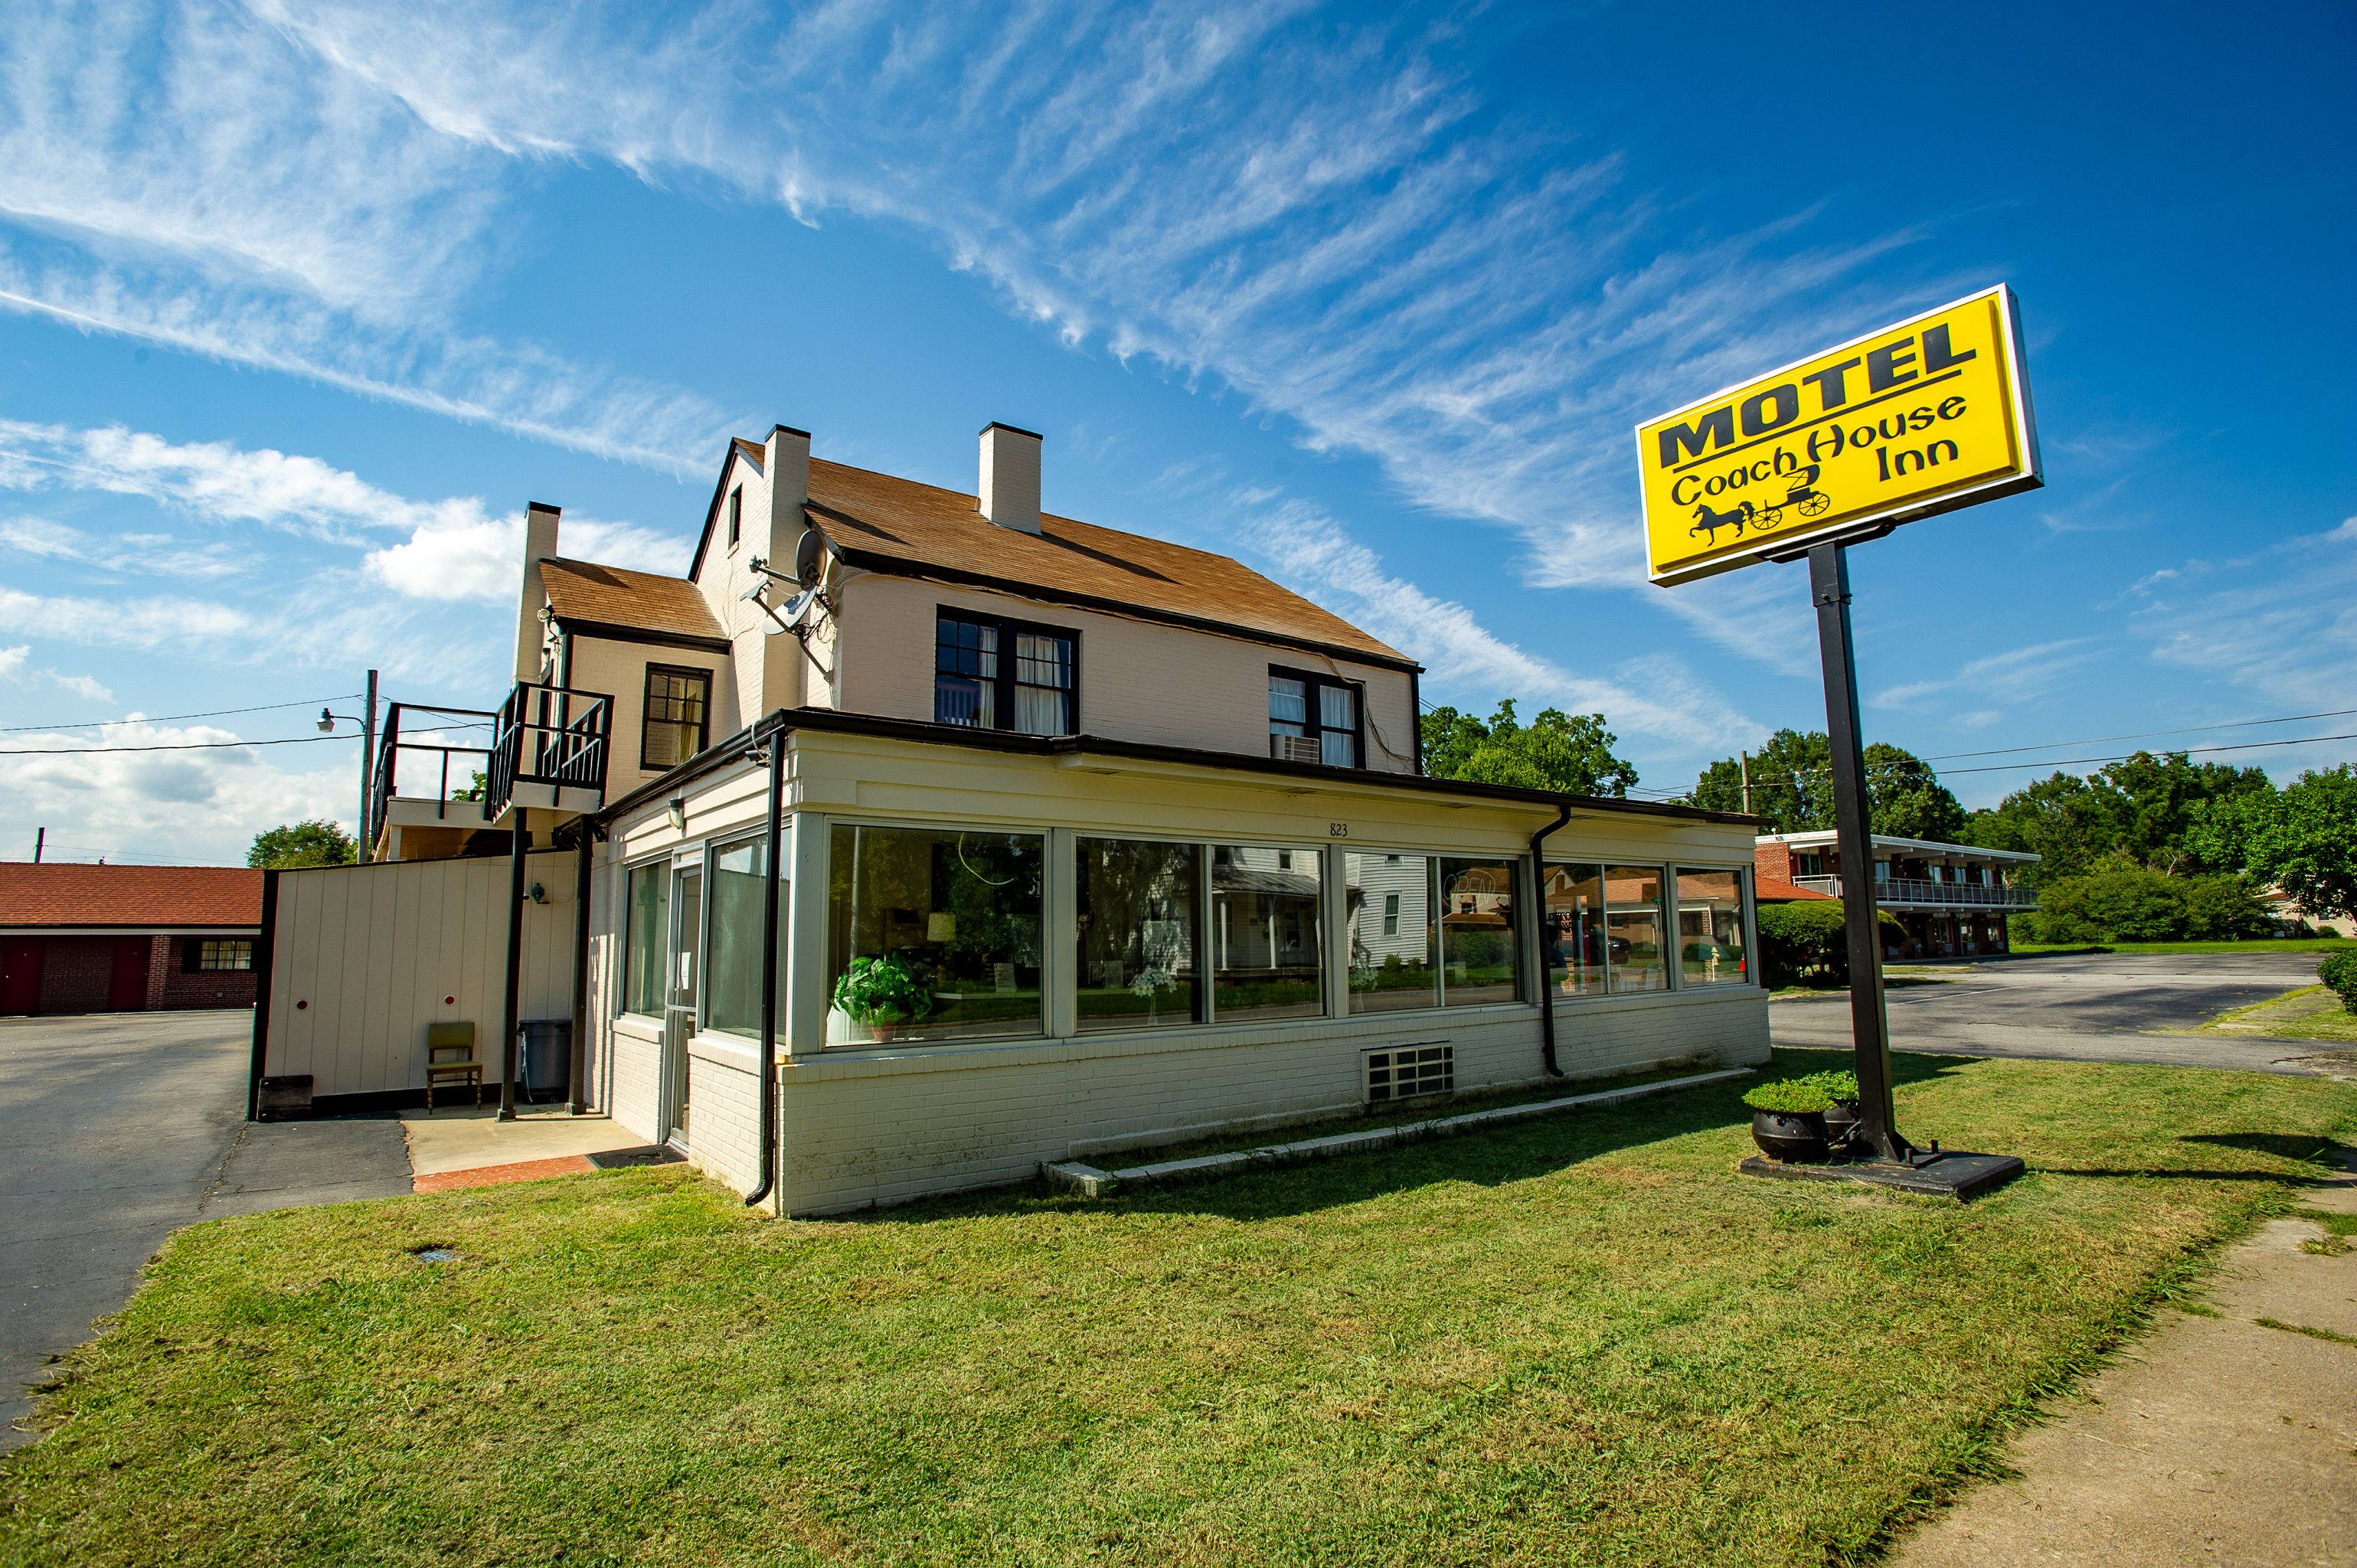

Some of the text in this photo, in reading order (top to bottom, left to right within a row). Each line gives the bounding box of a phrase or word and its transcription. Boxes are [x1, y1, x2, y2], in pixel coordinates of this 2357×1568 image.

[1658, 322, 1977, 469] MOTEL
[1671, 396, 1967, 506] Coach House
[1875, 439, 1959, 482] Inn
[1330, 823, 1348, 837] 823
[1443, 874, 1492, 905] OPEN
